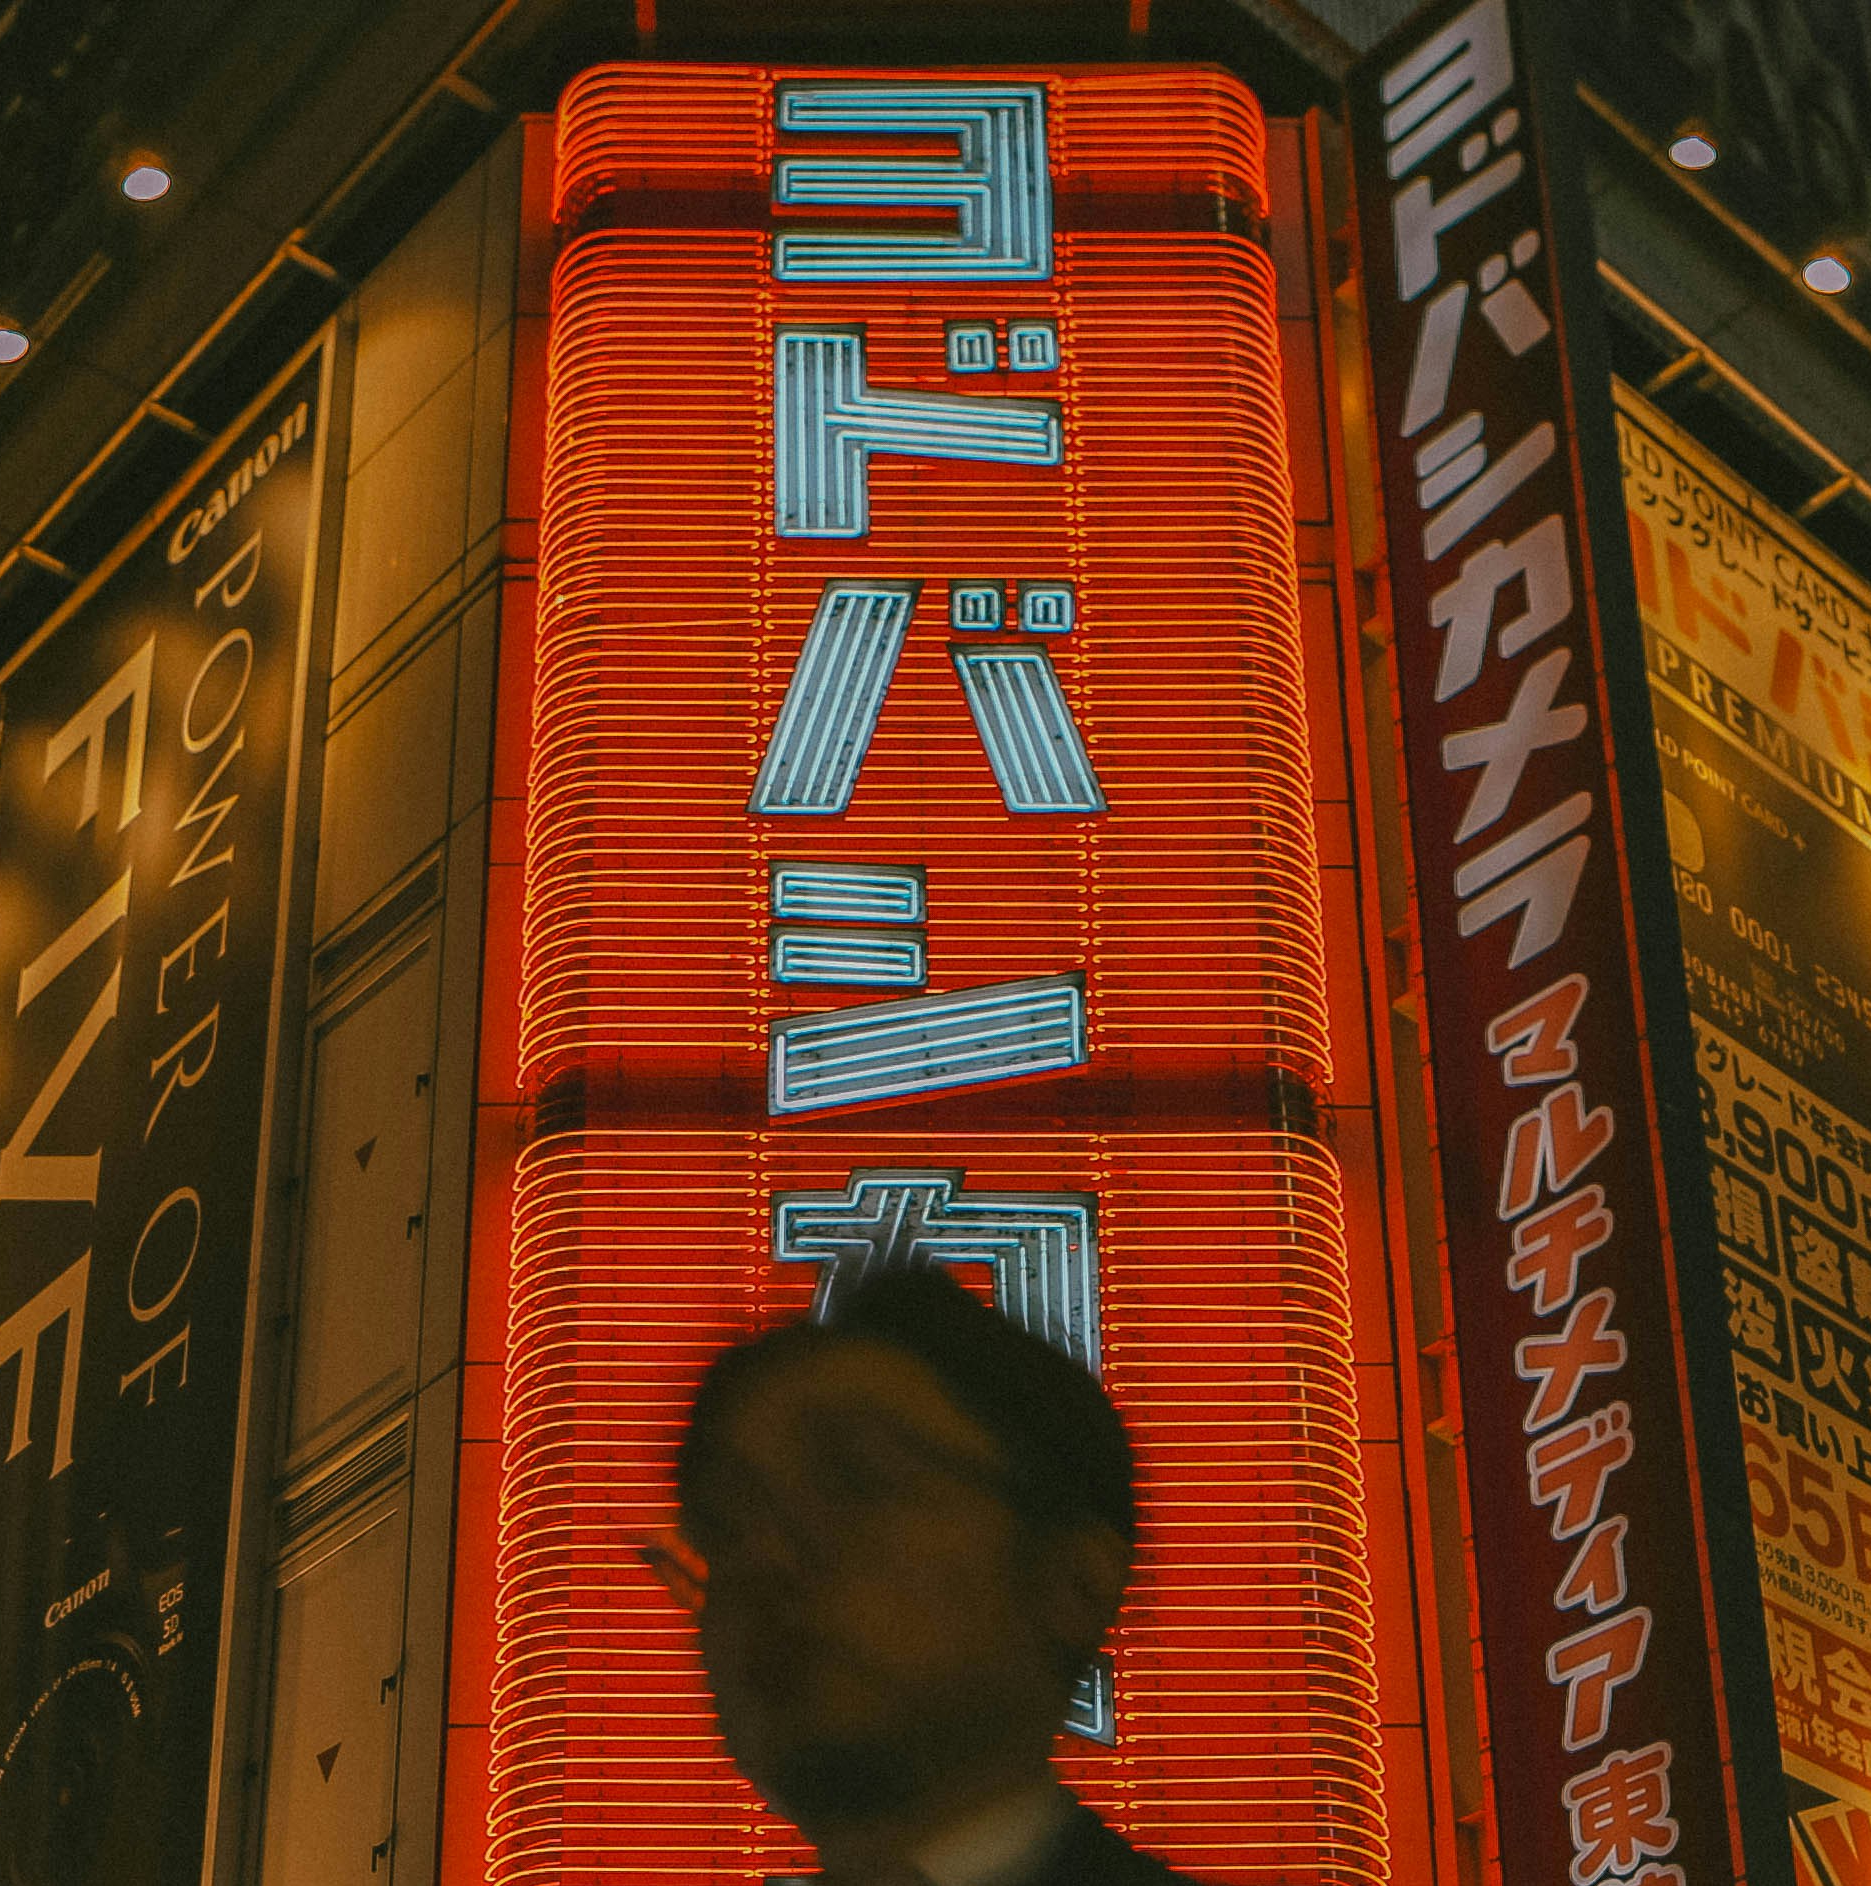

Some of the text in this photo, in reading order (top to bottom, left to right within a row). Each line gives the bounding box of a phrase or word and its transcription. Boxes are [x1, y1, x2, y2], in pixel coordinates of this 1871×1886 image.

[167, 396, 311, 568] Canon
[1379, 0, 1594, 970] ヨドバシカメラ
[1619, 430, 1852, 628] LD POINT CARD
[1683, 746, 1736, 799] POINT
[118, 525, 266, 1416] POWER OF
[41, 1568, 112, 1630] Canon
[156, 1580, 187, 1615] EOS
